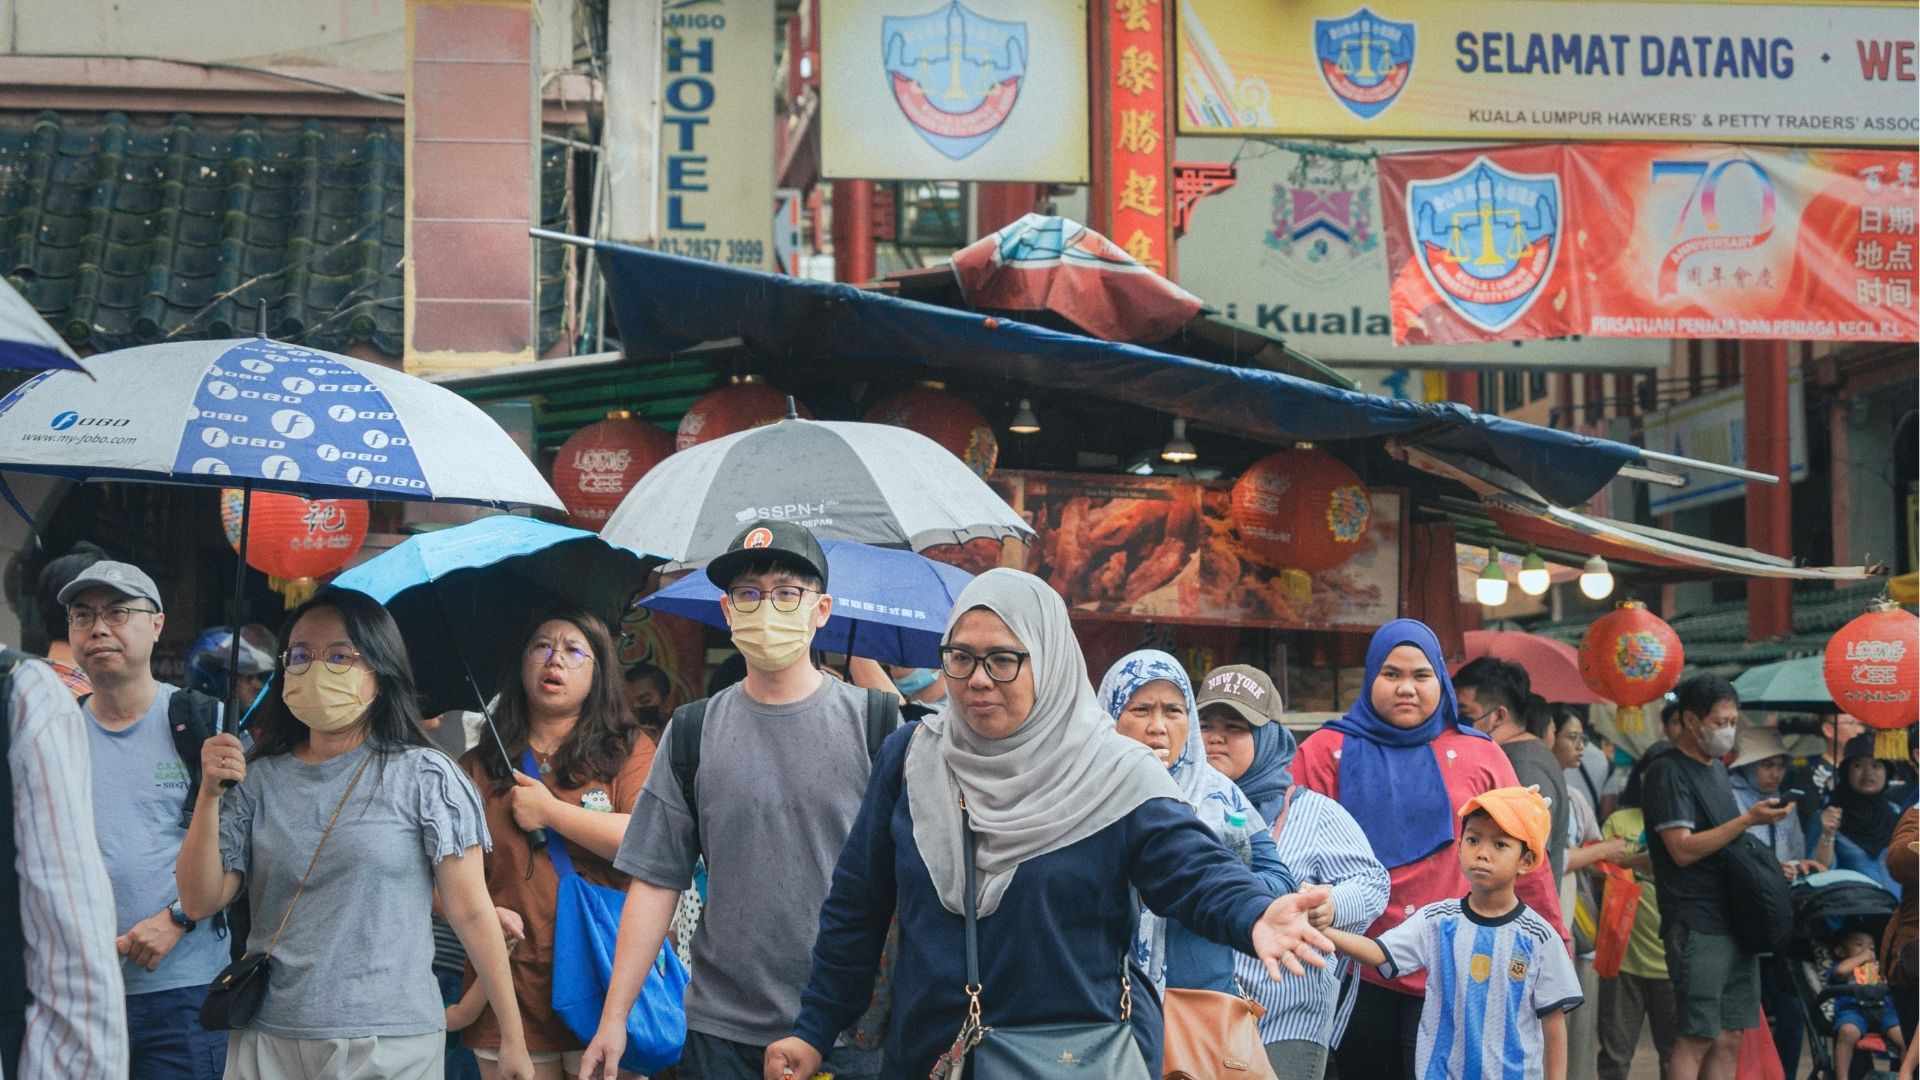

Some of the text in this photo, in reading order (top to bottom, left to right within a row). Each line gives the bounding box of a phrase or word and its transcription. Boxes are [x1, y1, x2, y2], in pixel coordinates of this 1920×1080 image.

[669, 14, 726, 30] MIGO
[1456, 31, 1630, 75] SELAMAT
[1641, 35, 1795, 79] DATANG
[664, 36, 716, 231] HOTEL
[1469, 109, 1527, 124] KUALA
[1532, 111, 1602, 125] LUMPUR
[1702, 115, 1713, 127] &
[1718, 115, 1772, 129] PETTY
[1652, 159, 1776, 240] 70
[1859, 205, 1916, 236] 日期
[727, 239, 763, 264] 3999
[1855, 240, 1914, 272] 地点
[1856, 276, 1913, 309] 时间
[1257, 303, 1391, 336] Kuala
[1739, 319, 1771, 334] DAN
[1839, 321, 1875, 336] KECIL
[22, 433, 137, 445] www.my-fobo.com
[578, 471, 624, 493] KEE
[1208, 671, 1267, 700] NEW YORK
[1851, 664, 1897, 685] KEE
